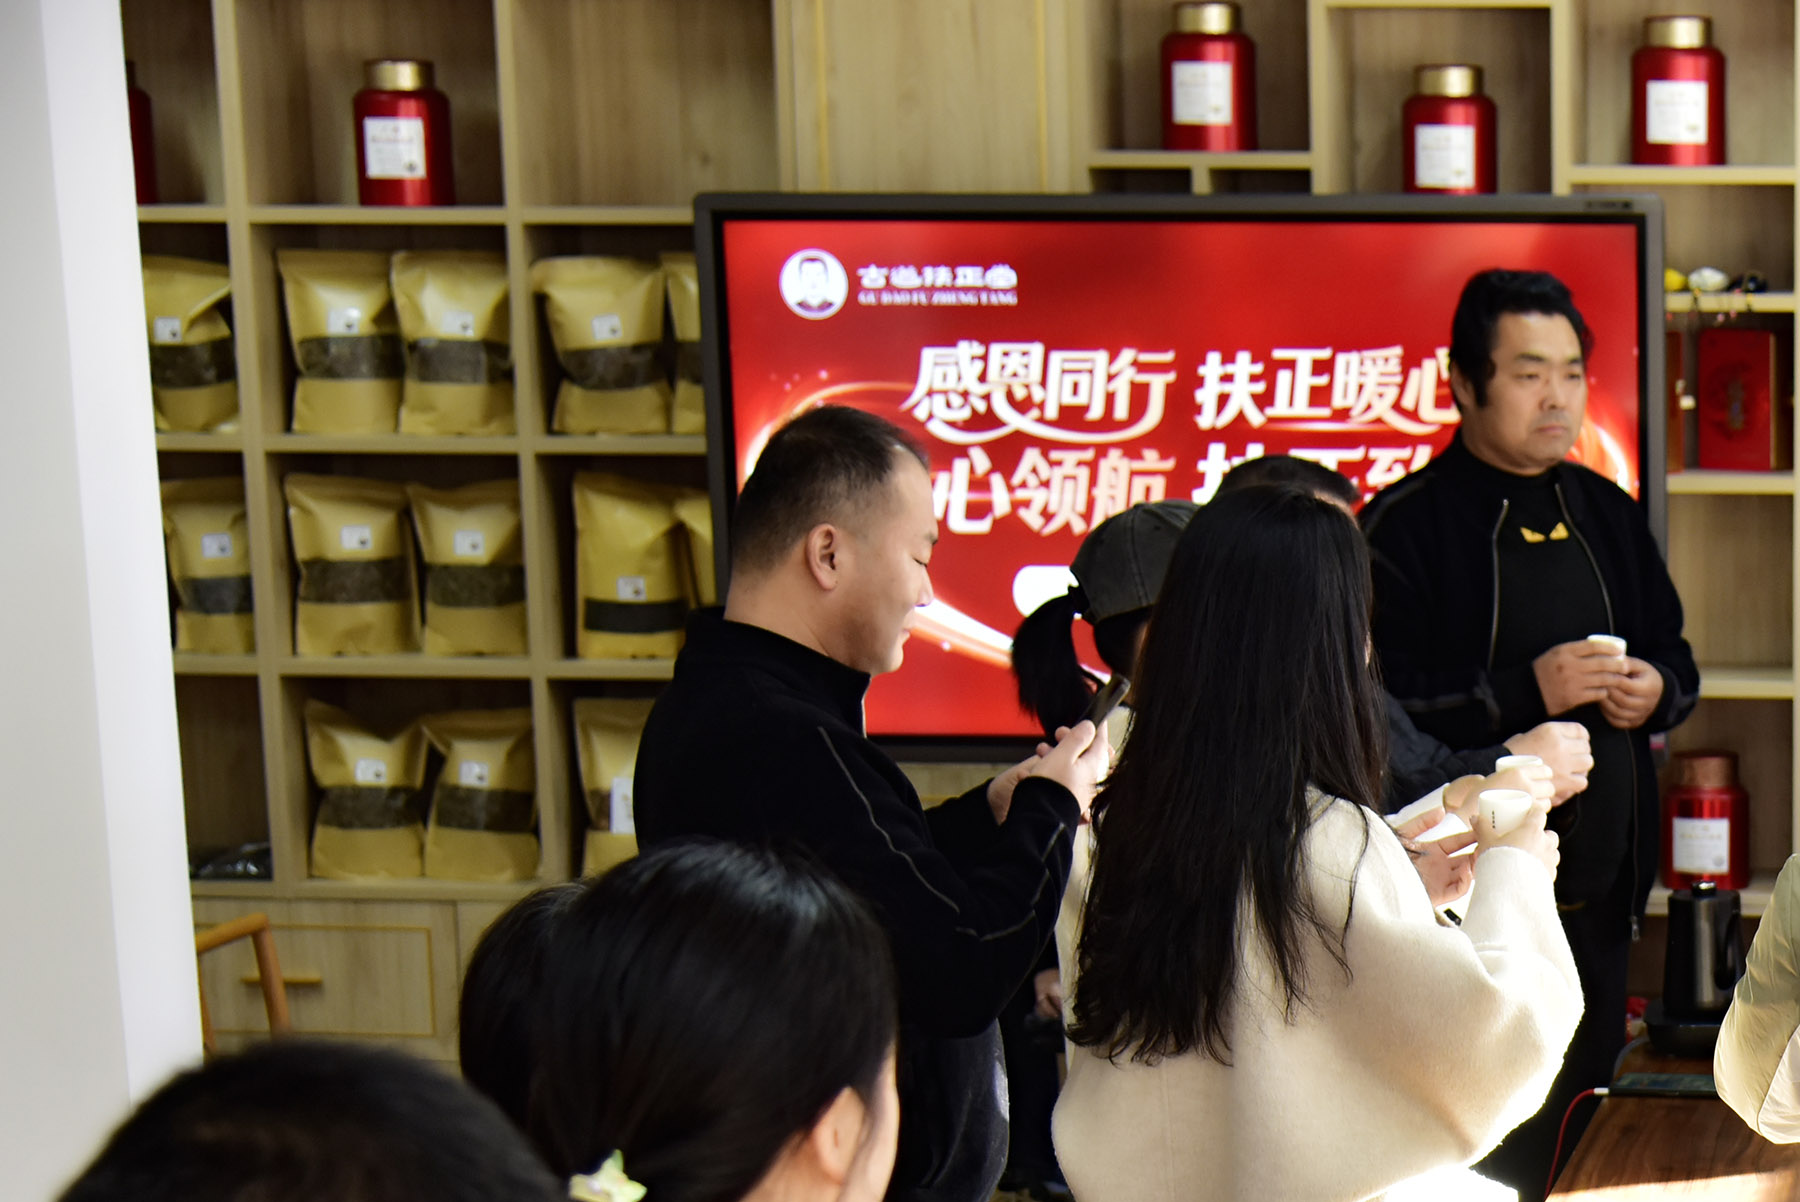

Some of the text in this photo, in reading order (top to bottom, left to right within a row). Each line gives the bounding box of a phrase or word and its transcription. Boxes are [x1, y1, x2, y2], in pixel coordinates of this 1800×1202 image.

[899, 340, 1462, 445] 感恩同行 扶正暖心
